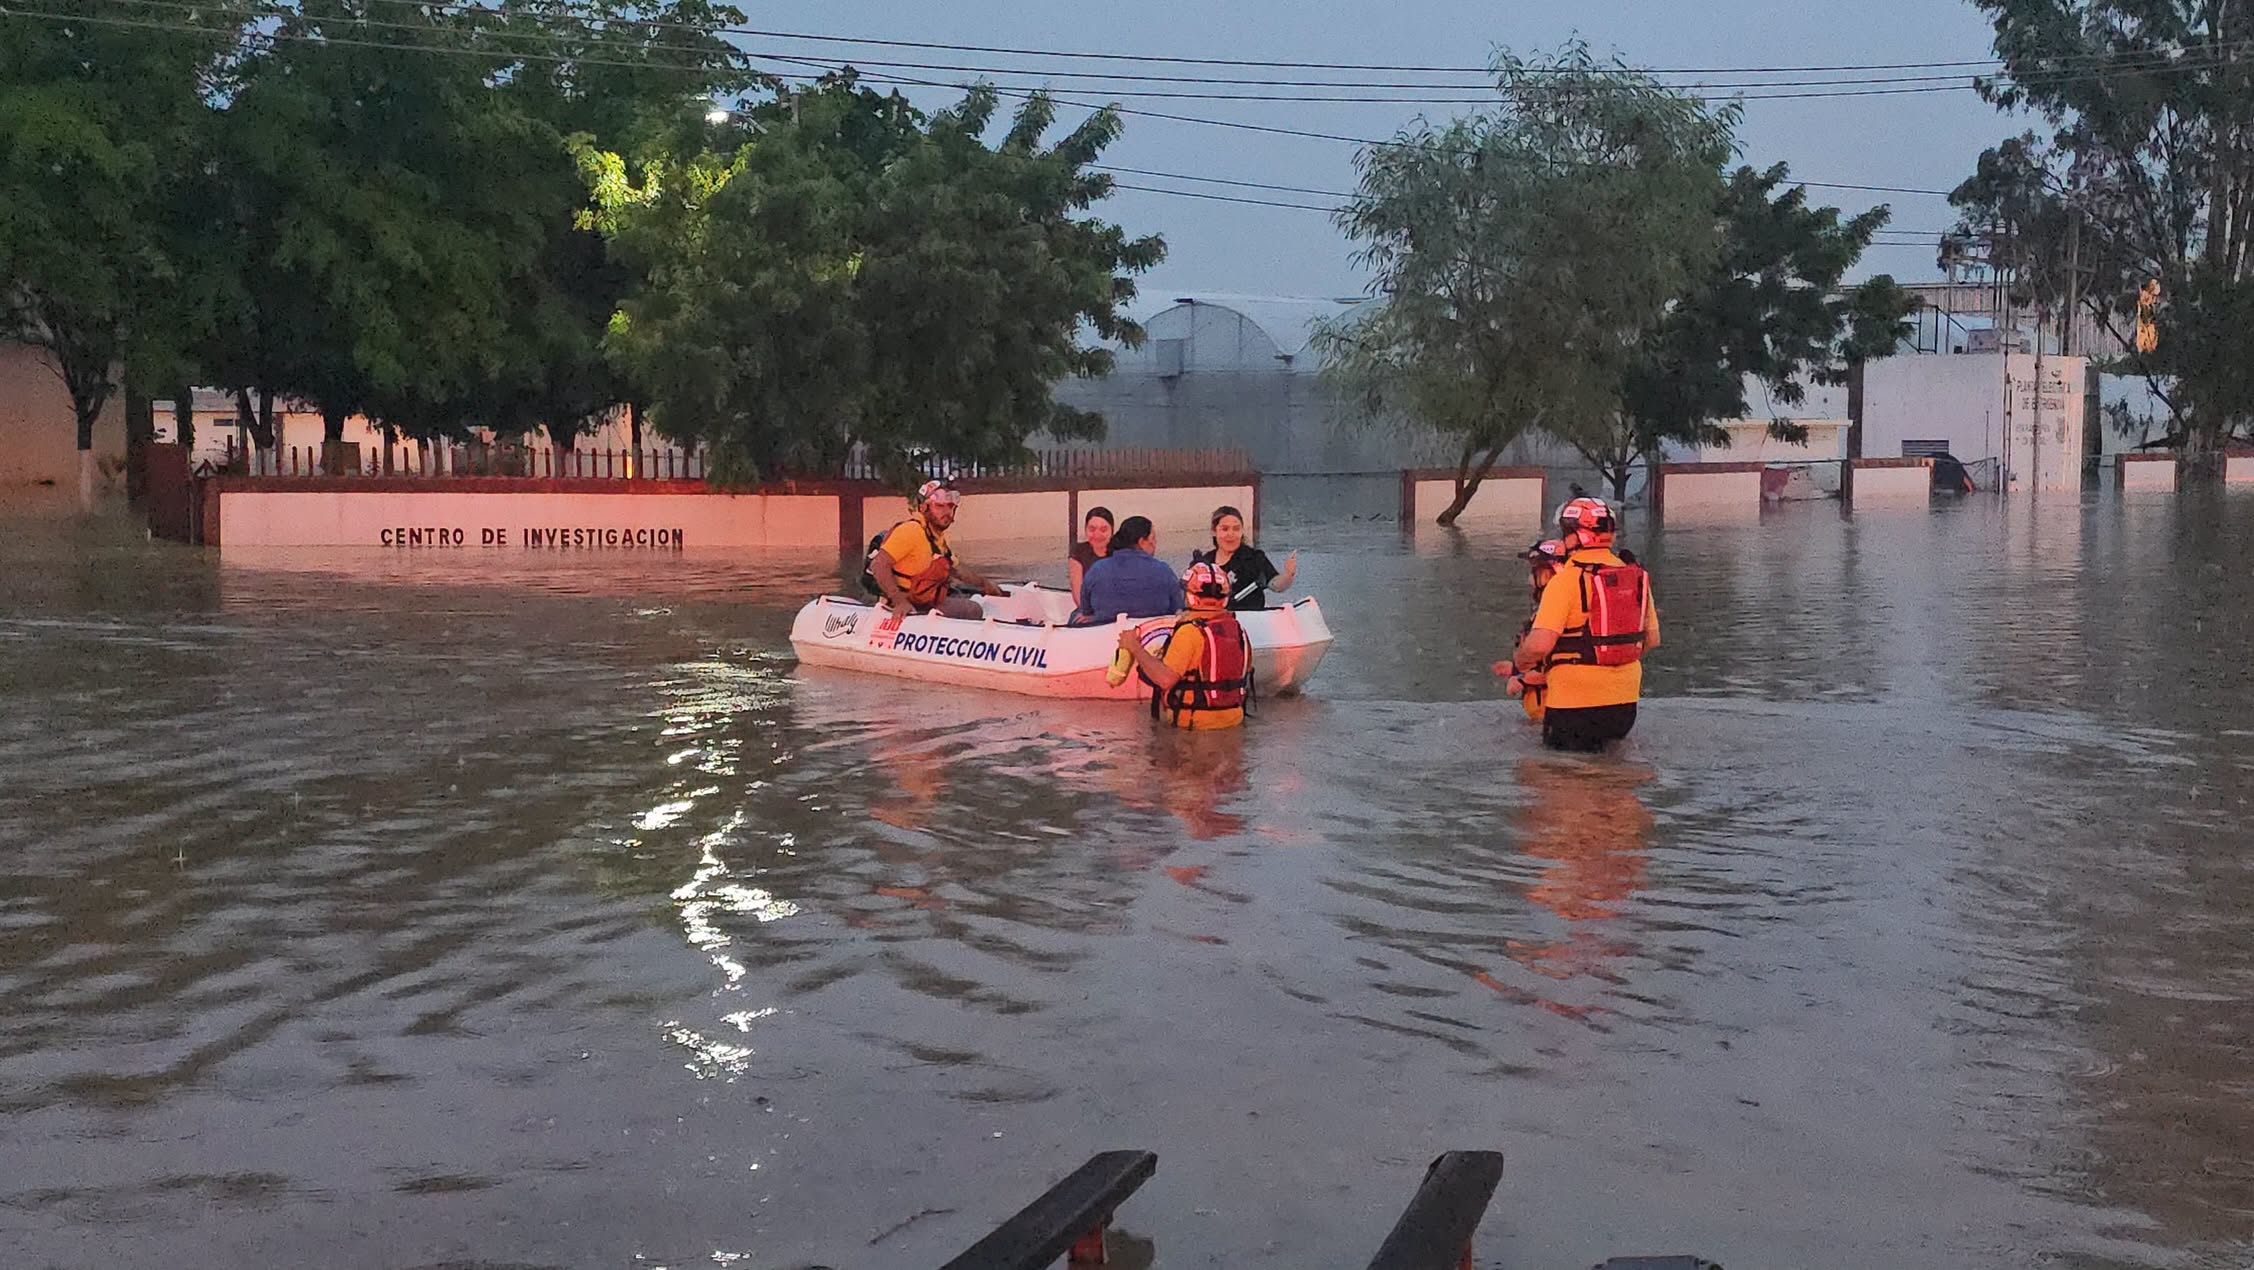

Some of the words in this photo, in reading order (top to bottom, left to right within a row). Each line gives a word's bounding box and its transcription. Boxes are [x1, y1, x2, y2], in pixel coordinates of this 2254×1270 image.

[380, 527, 465, 546] CENTRO
[481, 527, 507, 546] DE
[523, 528, 683, 547] INVESTIGACION
[893, 631, 1002, 662] PROTECCION
[1002, 645, 1048, 669] CIVIL
